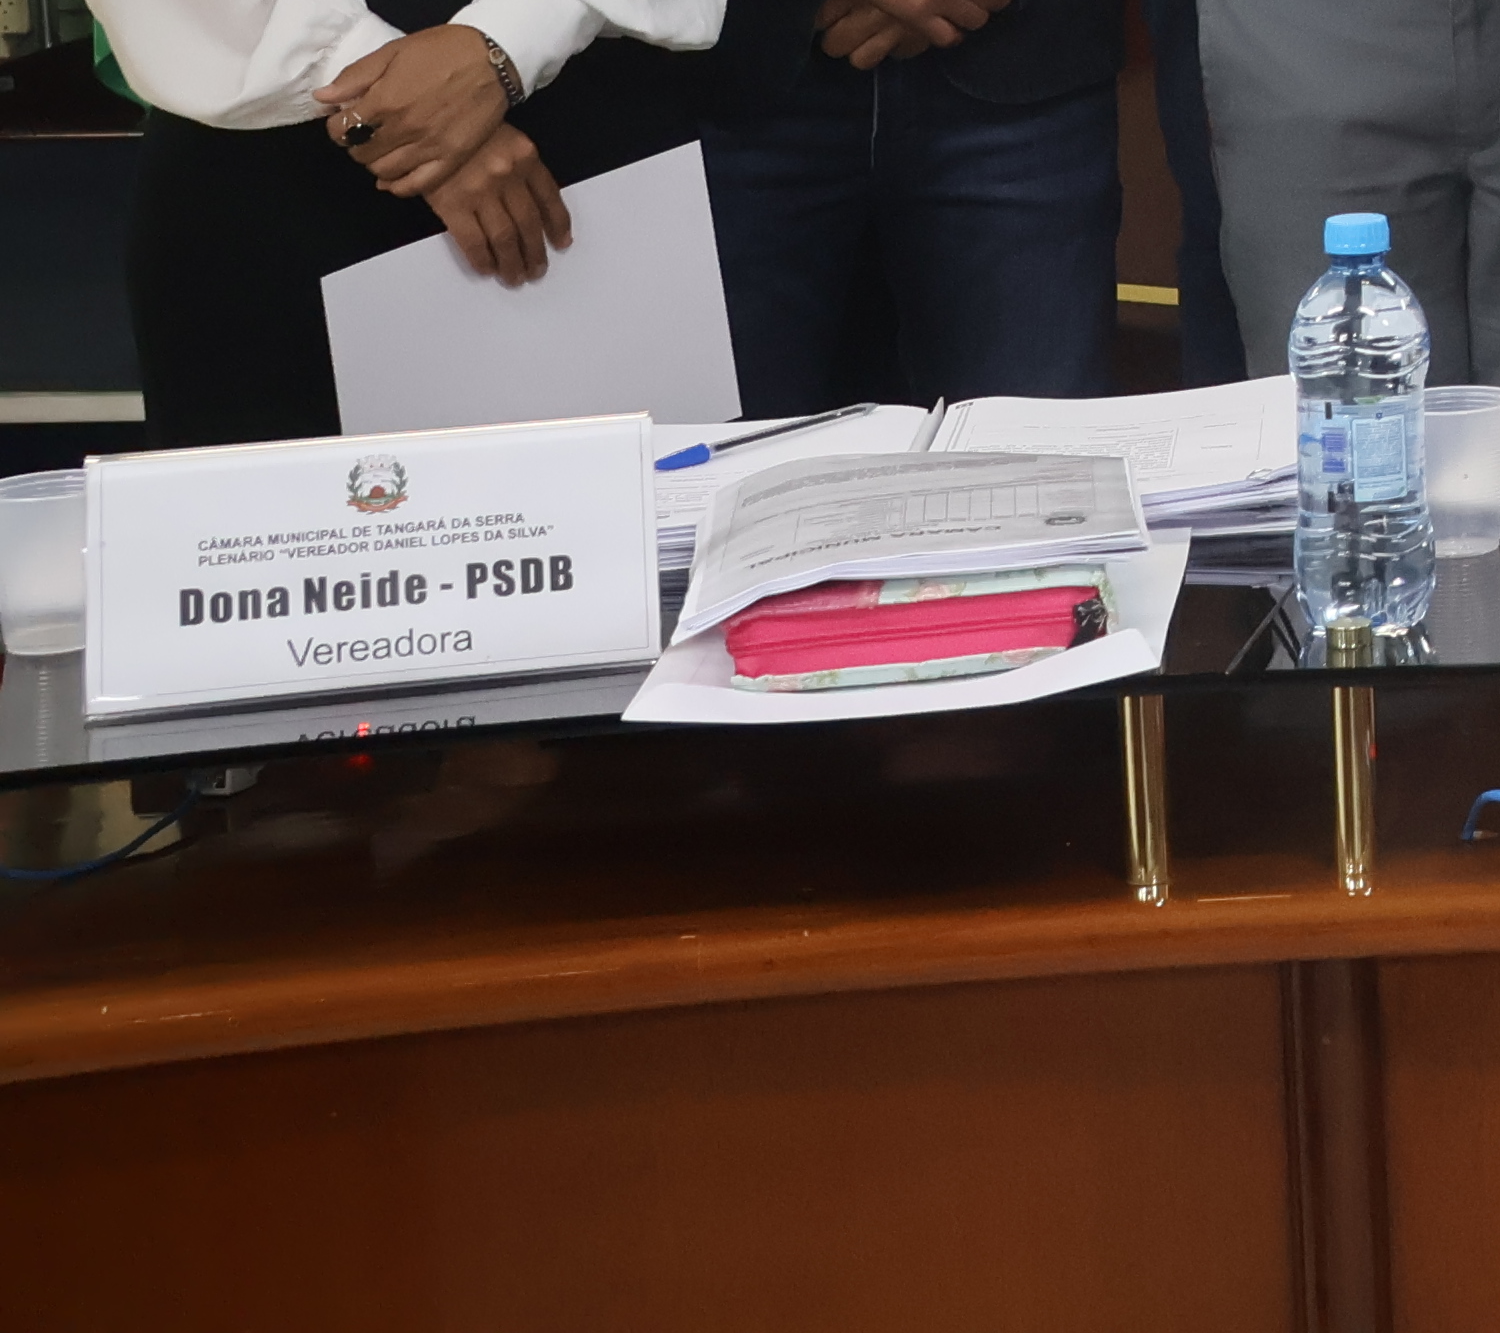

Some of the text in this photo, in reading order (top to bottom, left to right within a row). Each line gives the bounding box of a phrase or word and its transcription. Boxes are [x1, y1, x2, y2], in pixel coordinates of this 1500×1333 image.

[198, 511, 525, 552] CÂMARA MUNICIPAL DE TANGARÁ DA SERRA
[198, 547, 276, 567] PLENÁRIO
[373, 535, 429, 553] DANIEL
[431, 531, 480, 549] LOPES
[483, 529, 503, 543] DA
[178, 553, 575, 627] Dona Neide - PSDB
[286, 628, 474, 668] Vereadora
